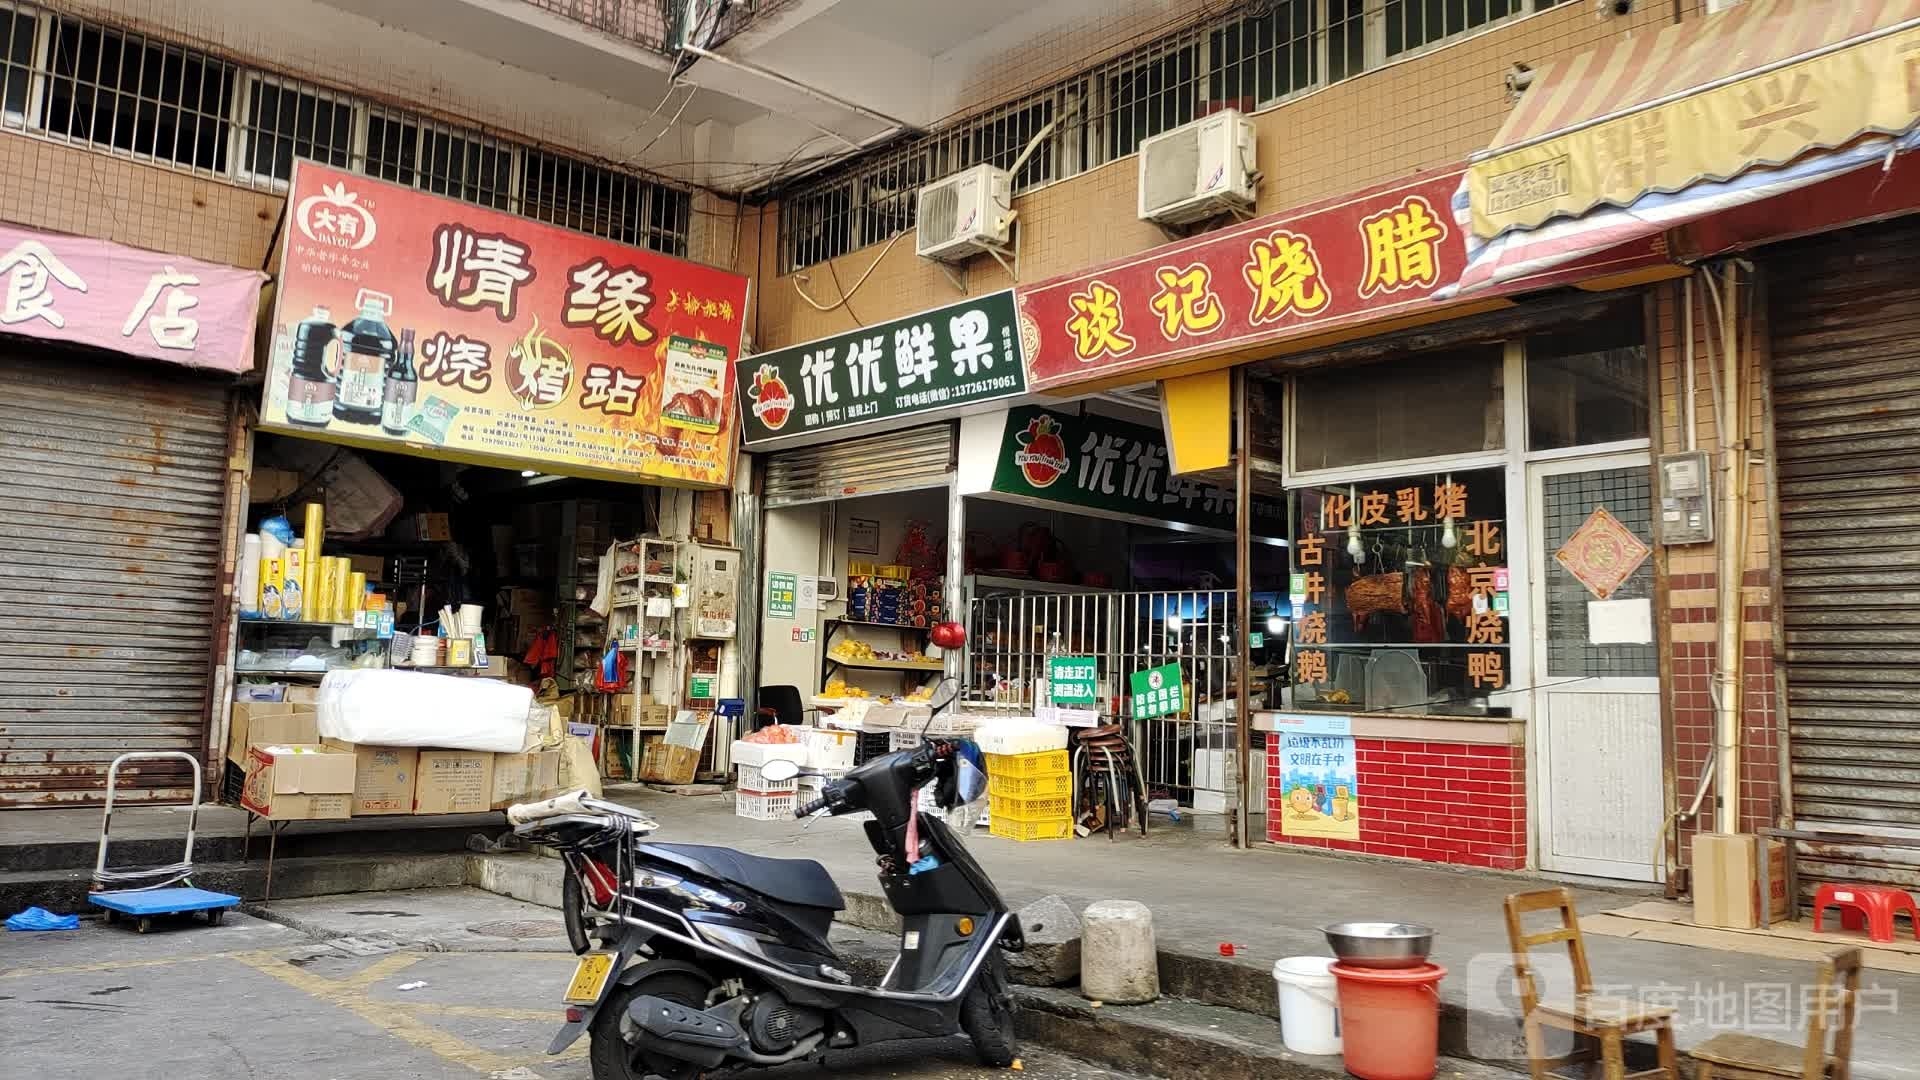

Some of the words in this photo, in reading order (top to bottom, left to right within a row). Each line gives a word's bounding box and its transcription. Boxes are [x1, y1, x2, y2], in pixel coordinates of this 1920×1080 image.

[313, 207, 359, 238] 大有
[0, 240, 200, 350] 食店
[430, 225, 655, 343] 情缘
[1068, 203, 1443, 358] 谈记烧腊
[423, 333, 642, 413] 烧烤站
[800, 309, 994, 407] 优优鲜果
[1325, 484, 1468, 528] 化皮乳猪
[1296, 532, 1328, 685] 古井烧鹅
[1465, 521, 1504, 689] 北京烧鸭
[1054, 666, 1094, 680] 请走正门
[1287, 737, 1345, 749] 垃圾不乱扔
[1290, 752, 1345, 766] 文明在手中
